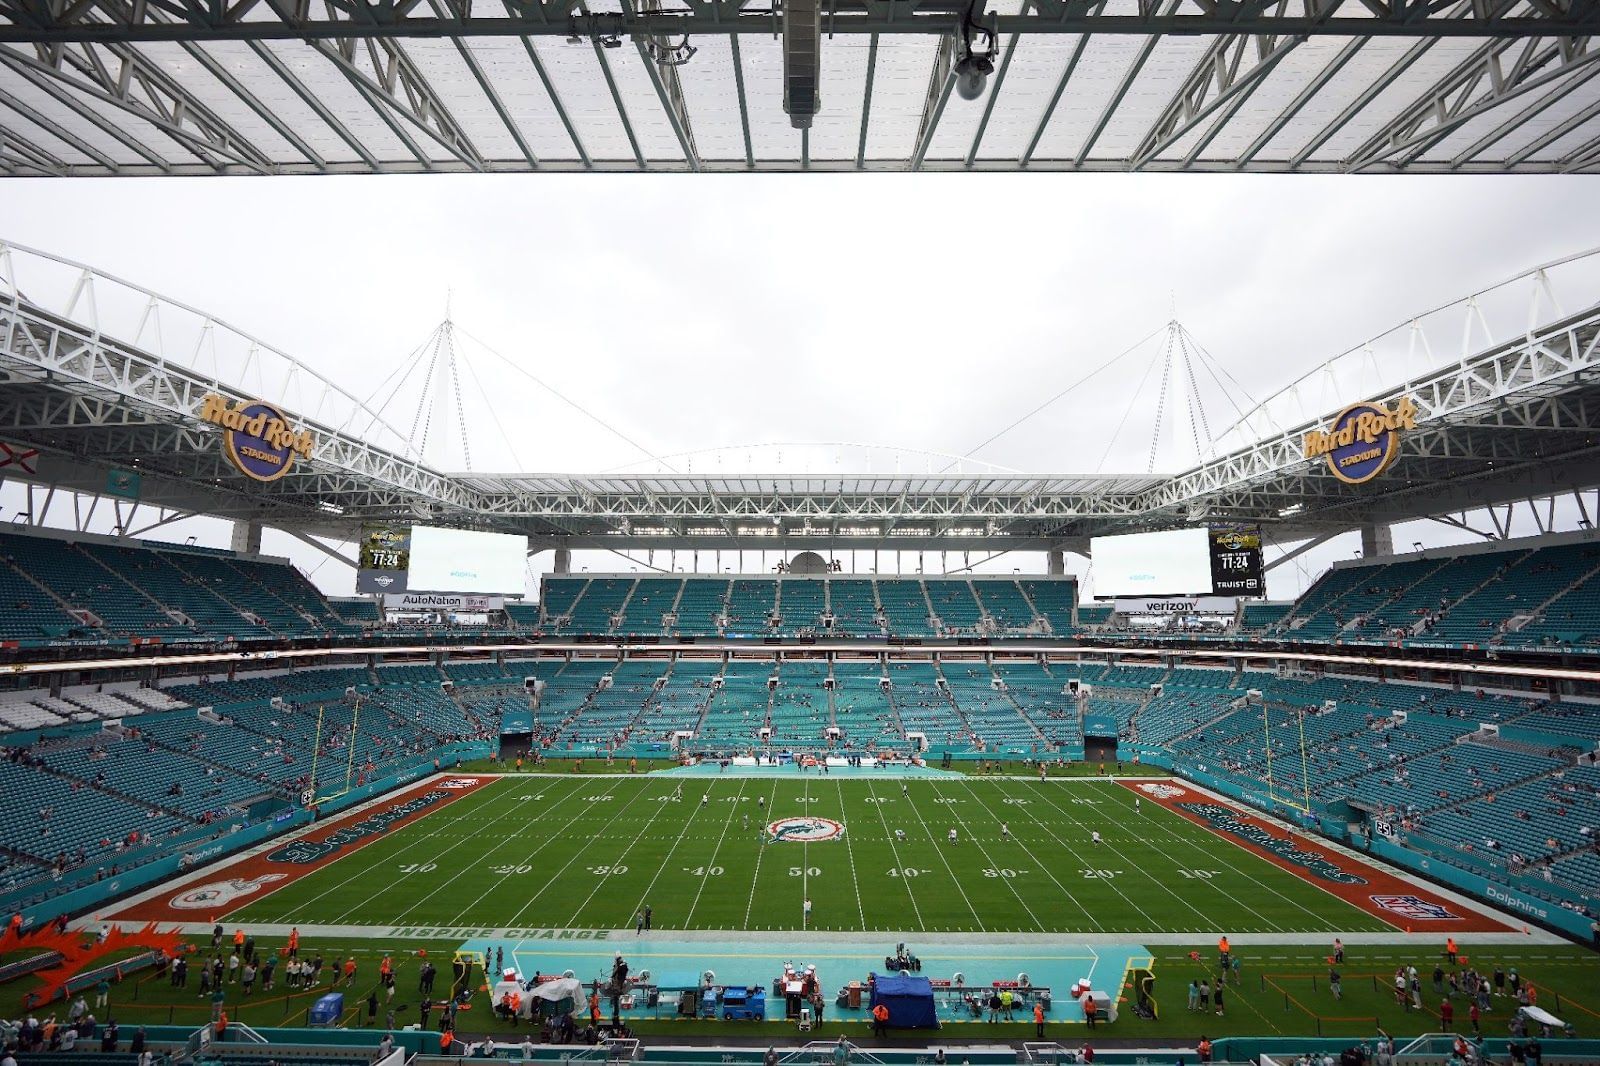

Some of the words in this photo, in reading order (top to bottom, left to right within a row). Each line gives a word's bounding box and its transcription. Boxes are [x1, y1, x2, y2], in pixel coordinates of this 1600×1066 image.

[201, 395, 269, 438] Hard
[262, 418, 315, 461] Rock
[1303, 417, 1356, 459] Hard
[1356, 396, 1419, 444] Rock
[241, 446, 282, 465] STADIUM
[1340, 448, 1382, 468] STADIUM
[373, 554, 398, 566] 77:24
[1222, 556, 1249, 569] 77:24
[1217, 580, 1246, 589] TRUIST
[402, 595, 461, 605] AutoNation
[1146, 600, 1194, 611] verizon
[1376, 821, 1390, 835] 25
[401, 863, 438, 873] 10
[495, 865, 533, 874] 20
[592, 865, 629, 875] 30
[691, 866, 724, 876] 40
[788, 867, 822, 877] 50
[886, 867, 919, 877] 40
[982, 868, 1017, 878] 30
[1078, 869, 1115, 879] 20
[1177, 869, 1213, 879] 10
[1486, 886, 1549, 918] Dolphins
[388, 927, 493, 938] INSPIRE
[503, 929, 610, 940] CHANGE
